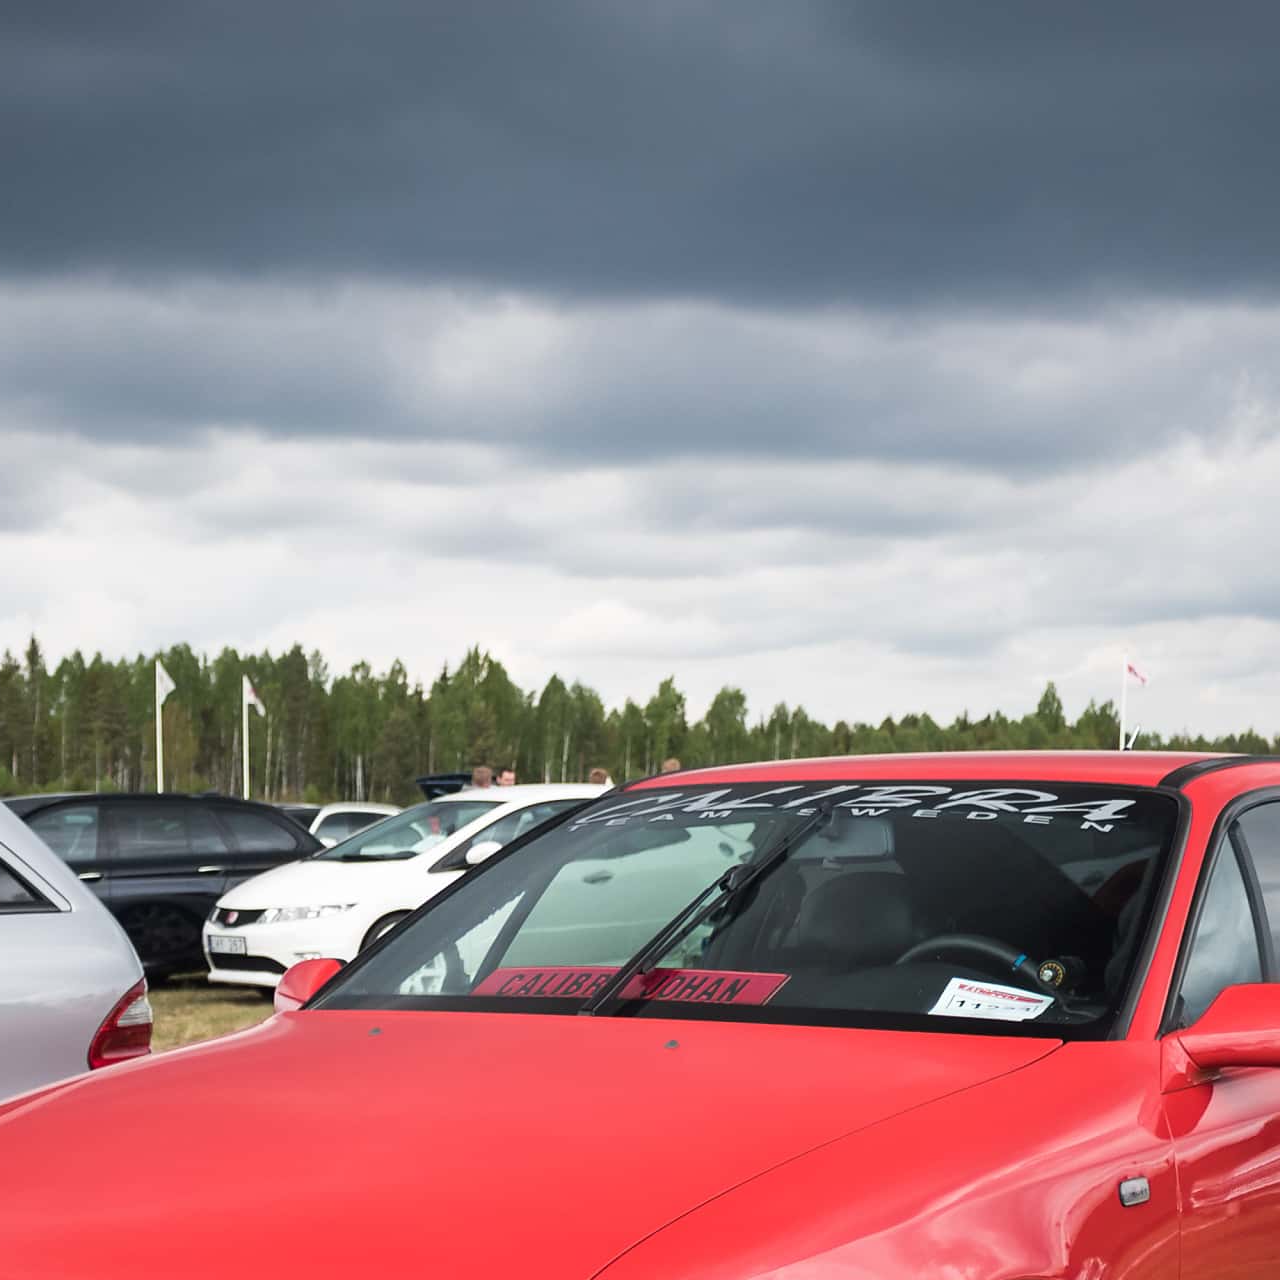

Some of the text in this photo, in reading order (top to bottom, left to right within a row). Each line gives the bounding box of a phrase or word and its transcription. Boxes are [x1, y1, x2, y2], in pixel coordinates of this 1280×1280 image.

[574, 784, 1136, 824] CALIBRA
[568, 807, 1114, 833] TEAM SWEDEN
[496, 973, 750, 1001] CALIBR JOHAN
